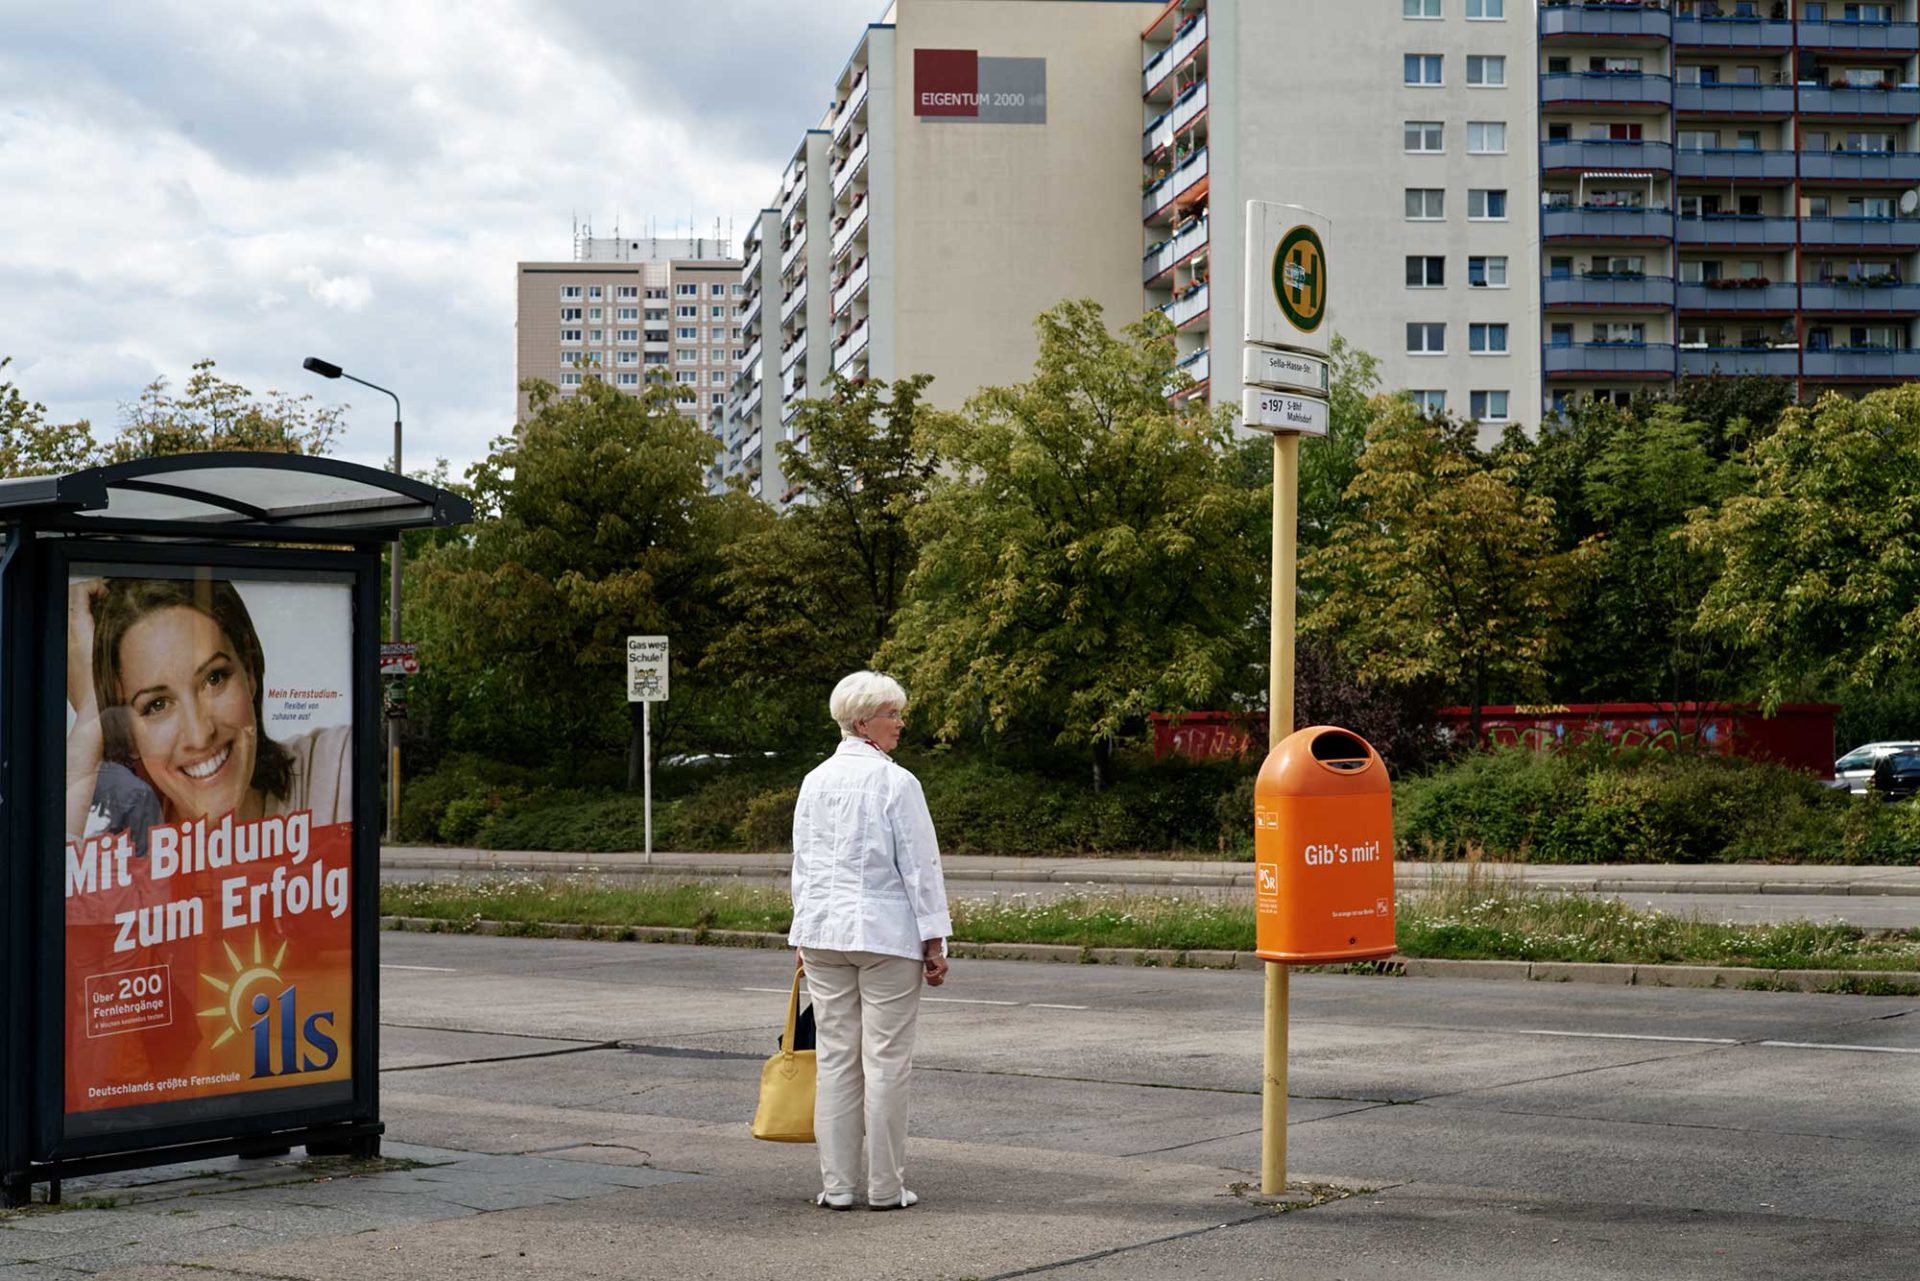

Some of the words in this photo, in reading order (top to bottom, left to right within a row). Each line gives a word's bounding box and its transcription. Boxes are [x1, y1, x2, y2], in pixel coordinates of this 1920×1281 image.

[921, 92, 990, 106] EIGENTUM
[993, 93, 1025, 106] 2000
[1291, 249, 1318, 309] H
[1268, 399, 1283, 412] 197
[629, 640, 647, 650] Gas
[629, 653, 664, 662] Schule!
[268, 689, 288, 699] Mein
[289, 688, 338, 699] Fernstudium
[284, 701, 307, 710] flexibel
[308, 702, 319, 710] von
[272, 712, 297, 720] zuhause
[298, 712, 311, 720] aus!
[65, 833, 132, 897] Mit
[151, 814, 309, 880] Bildung
[1304, 844, 1348, 866] Gib's
[1352, 841, 1380, 863] mir!
[114, 897, 203, 952] zum
[222, 859, 349, 929] Erfolg
[93, 991, 114, 1003] Über
[118, 974, 162, 999] 200
[93, 1000, 164, 1018] Fernlehrgänge
[250, 985, 338, 1080] ils
[88, 1081, 154, 1097] Deutschlands
[157, 1078, 188, 1092] größte
[191, 1072, 241, 1086] Fernschule
